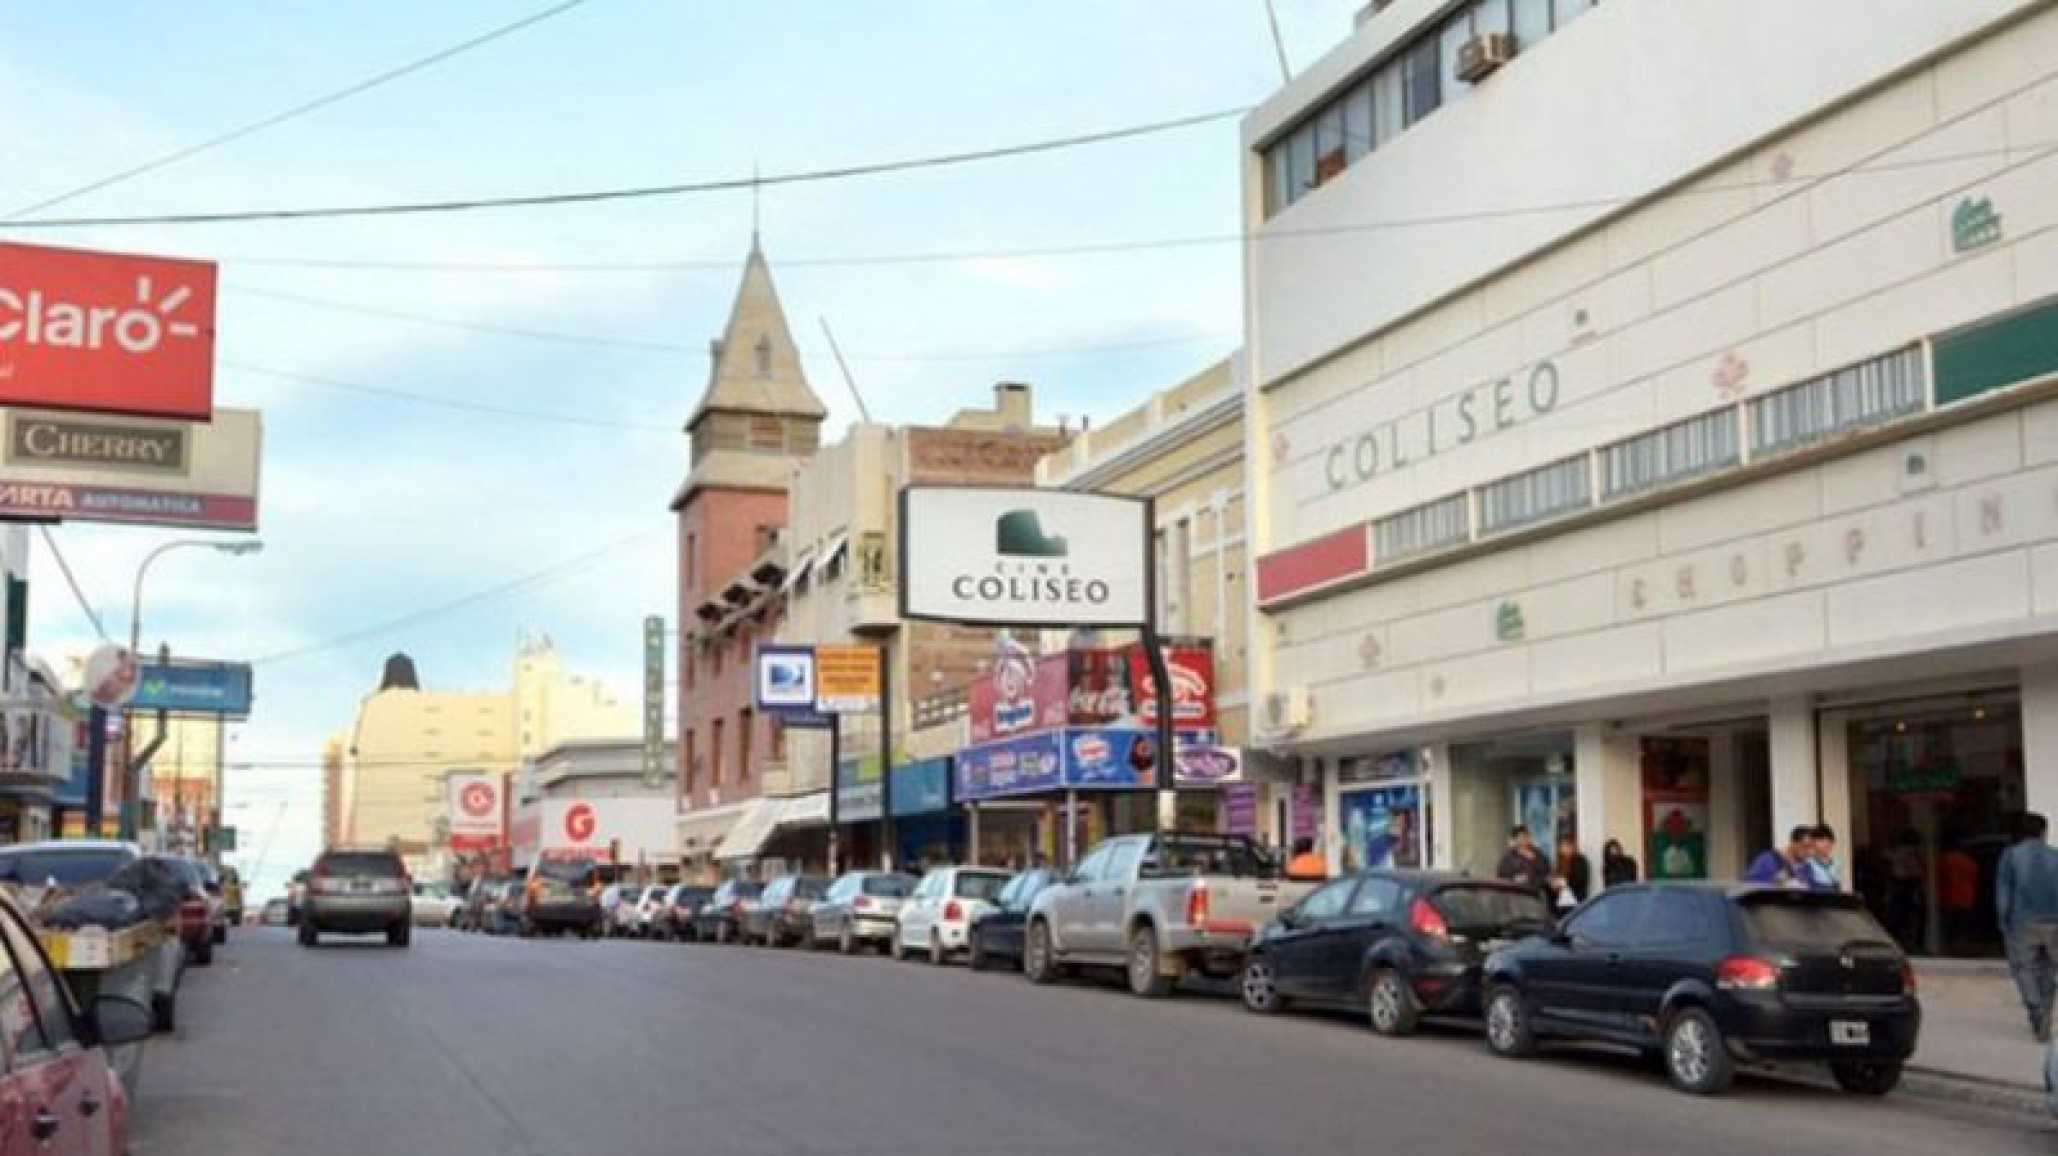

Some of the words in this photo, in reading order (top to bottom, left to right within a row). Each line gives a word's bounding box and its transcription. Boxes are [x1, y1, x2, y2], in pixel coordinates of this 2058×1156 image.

[1325, 359, 1560, 491] COLISEO
[994, 562, 1070, 576] CINE
[951, 574, 1110, 604] COLISEO
